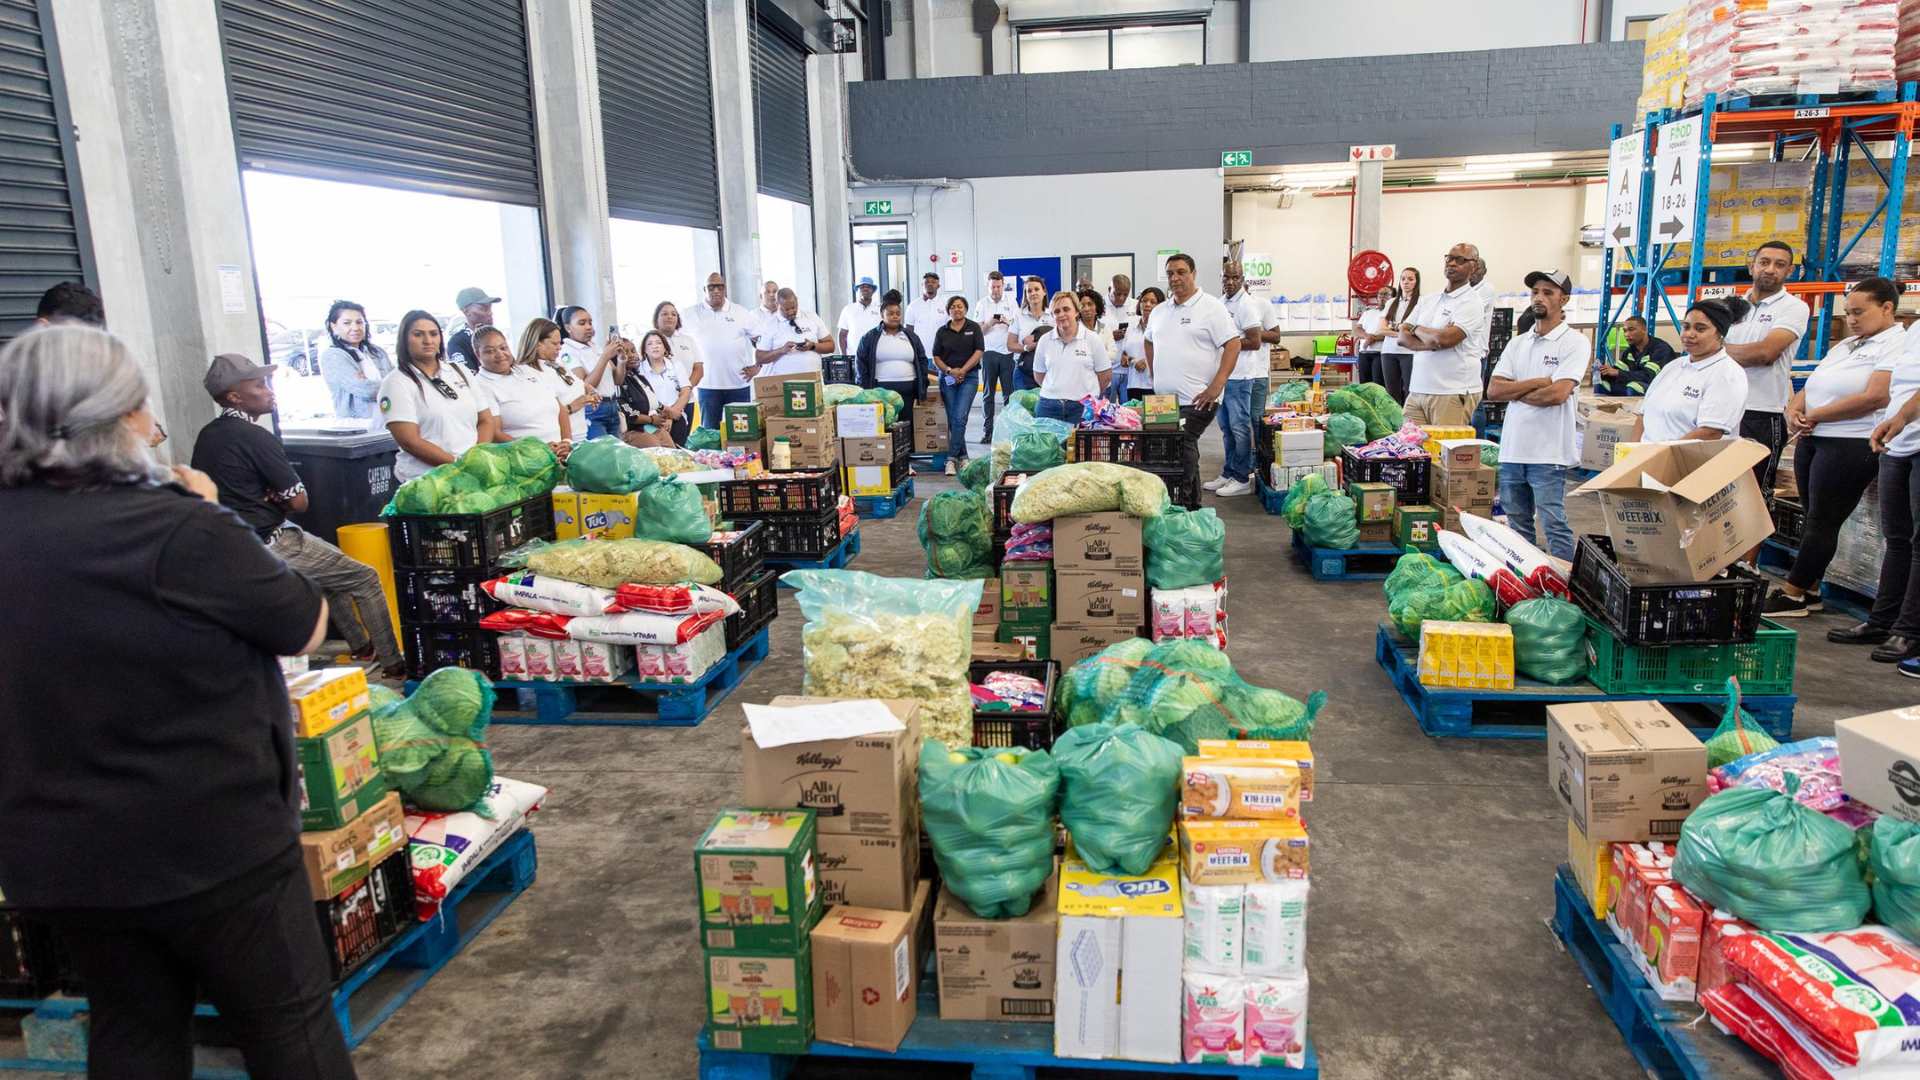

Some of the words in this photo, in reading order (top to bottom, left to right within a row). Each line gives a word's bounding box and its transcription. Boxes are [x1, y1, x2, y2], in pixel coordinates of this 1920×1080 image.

[1670, 156, 1682, 187] A
[1619, 167, 1629, 195] A
[1661, 194, 1686, 210] 18-26
[586, 514, 607, 528] TUC
[1616, 511, 1664, 525] WEET-BIX
[796, 752, 842, 768] Kellogg's
[804, 790, 837, 804] Bran
[1122, 880, 1167, 893] TUC
